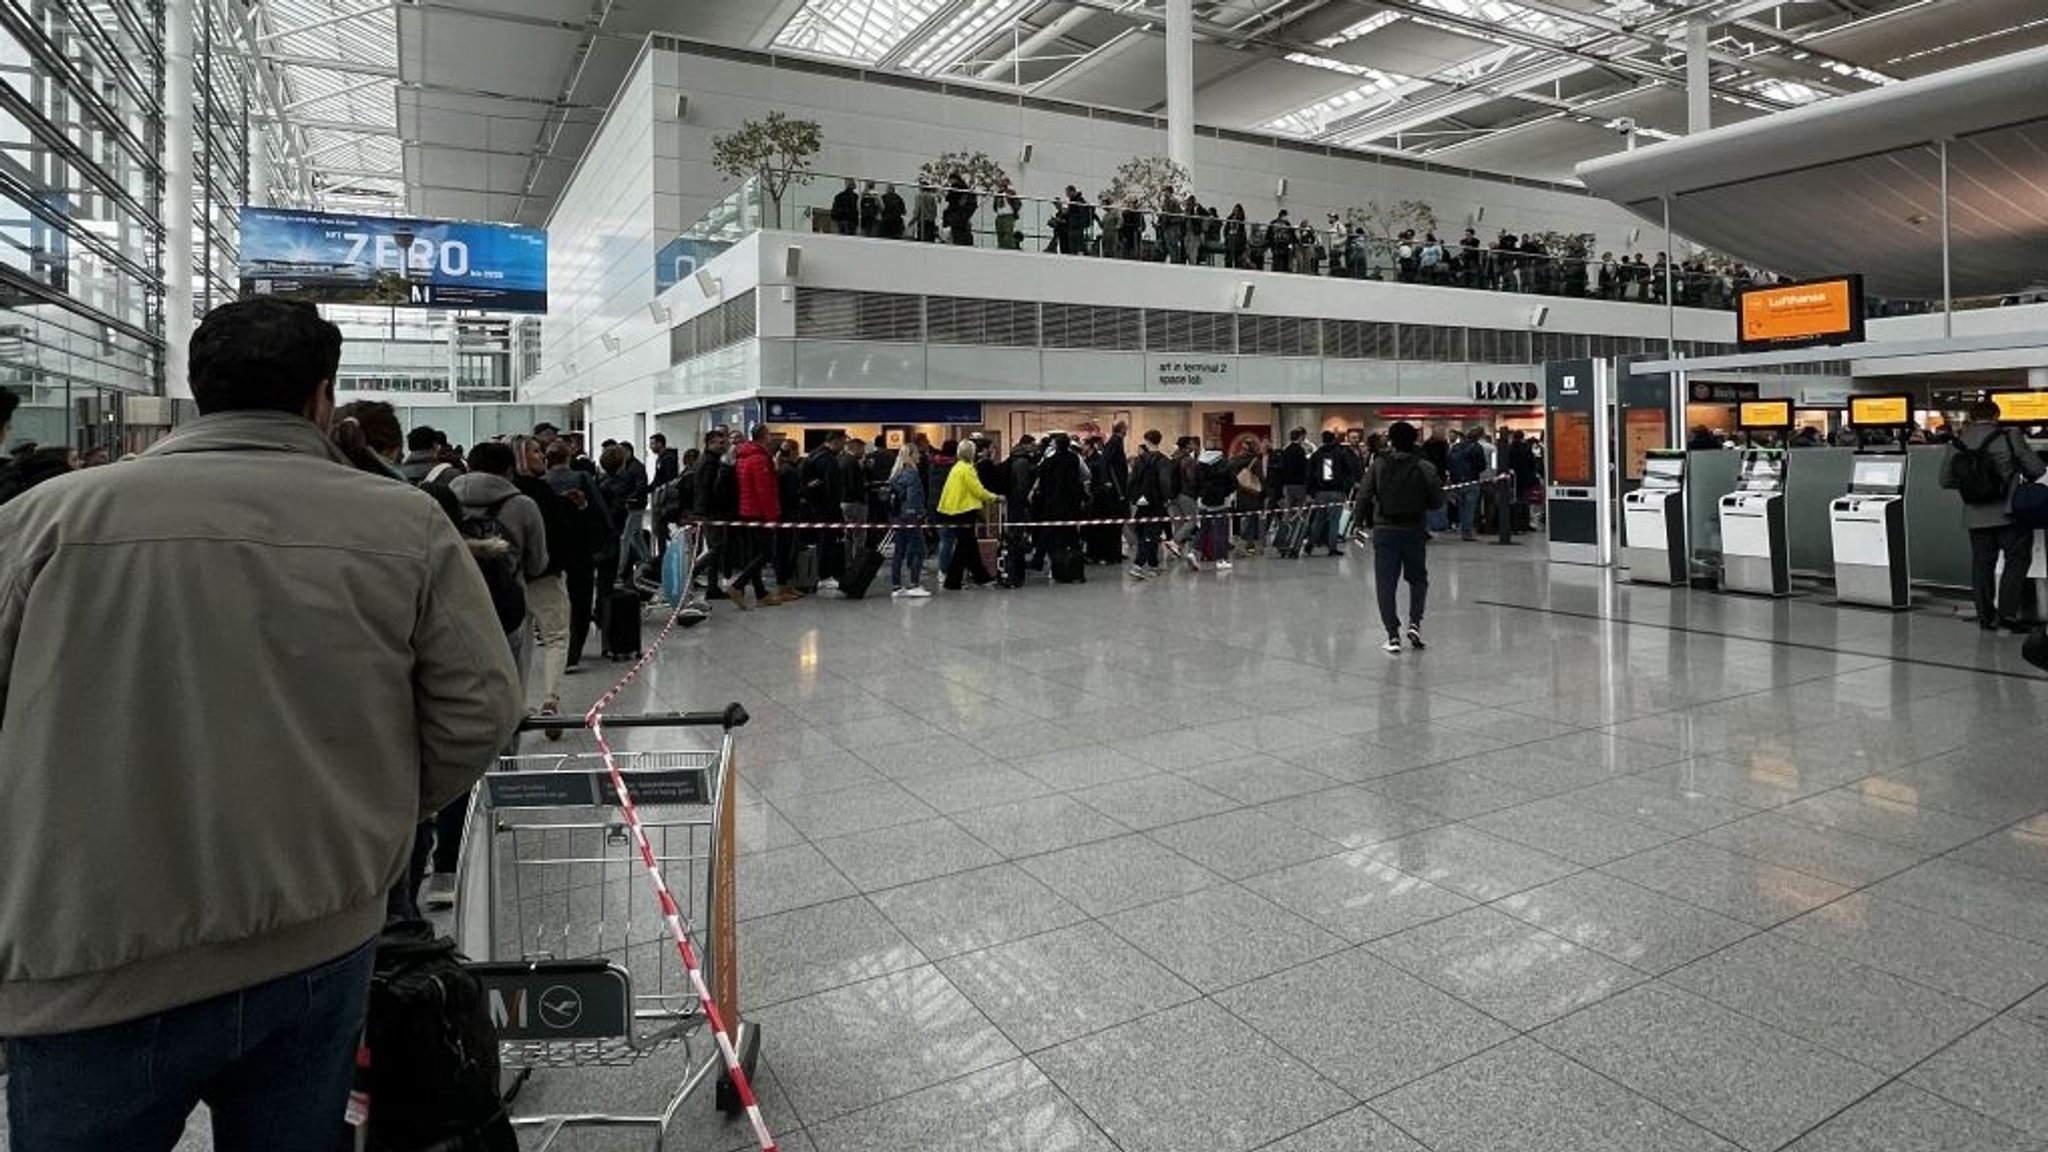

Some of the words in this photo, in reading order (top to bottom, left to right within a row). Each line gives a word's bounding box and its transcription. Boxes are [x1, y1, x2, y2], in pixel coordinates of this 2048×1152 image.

[342, 232, 469, 277] ZERO
[1768, 292, 1827, 307] Lufthansa
[1184, 362, 1219, 373] terminal
[1220, 363, 1227, 373] 2
[1159, 375, 1186, 386] space
[1473, 380, 1539, 401] LLOYD
